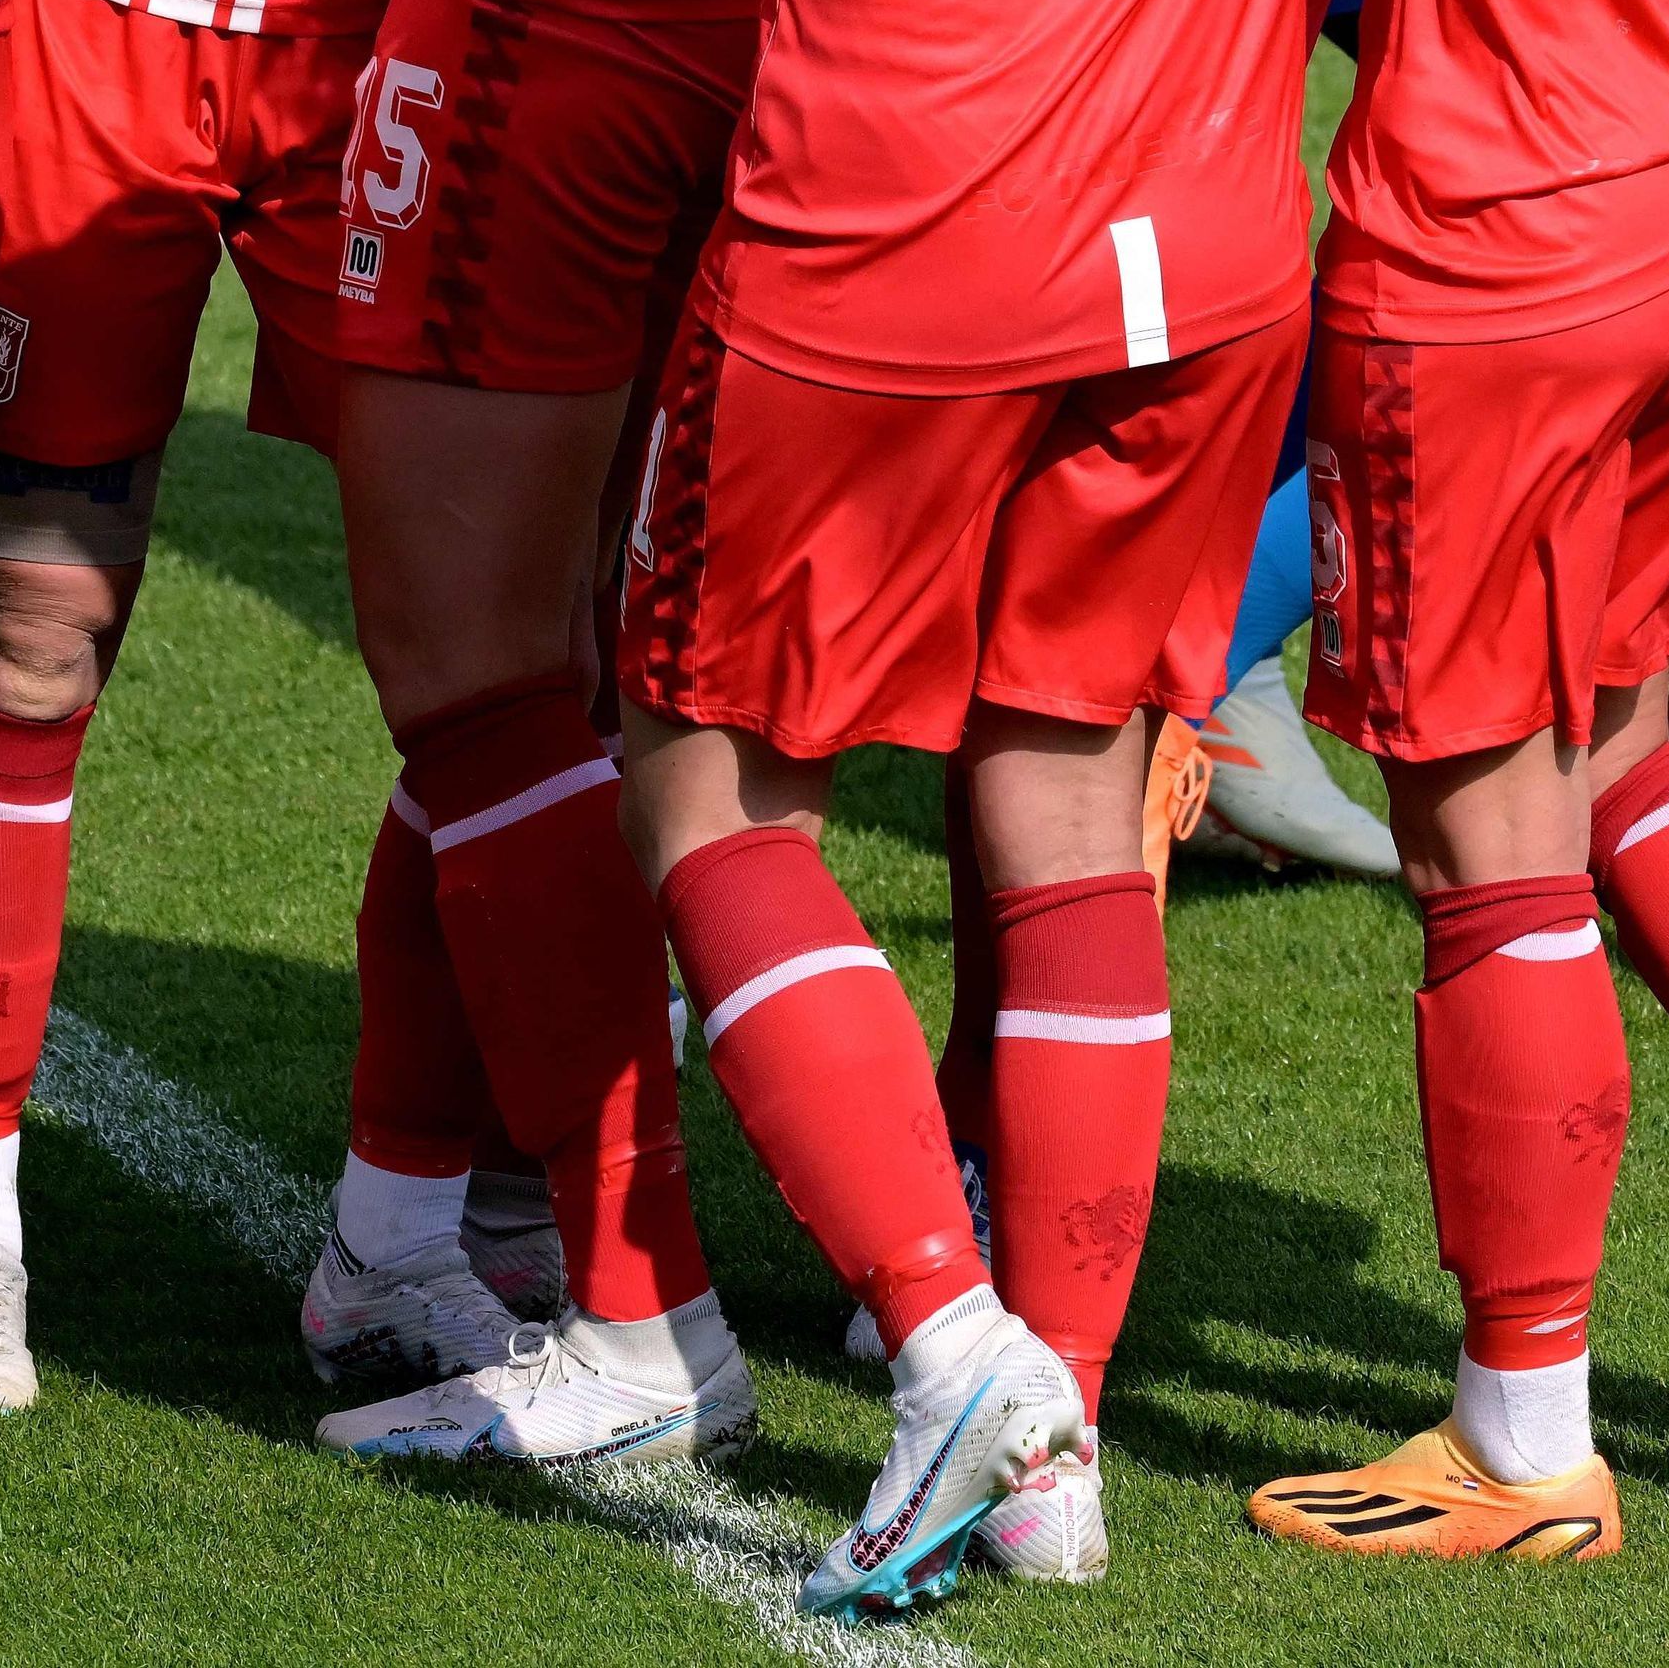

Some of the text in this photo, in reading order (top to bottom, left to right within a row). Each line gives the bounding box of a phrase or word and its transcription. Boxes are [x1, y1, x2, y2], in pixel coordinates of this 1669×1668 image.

[338, 283, 375, 305] MEYBA
[1445, 1473, 1461, 1484] MO
[1063, 1492, 1076, 1559] MERCURIAL
